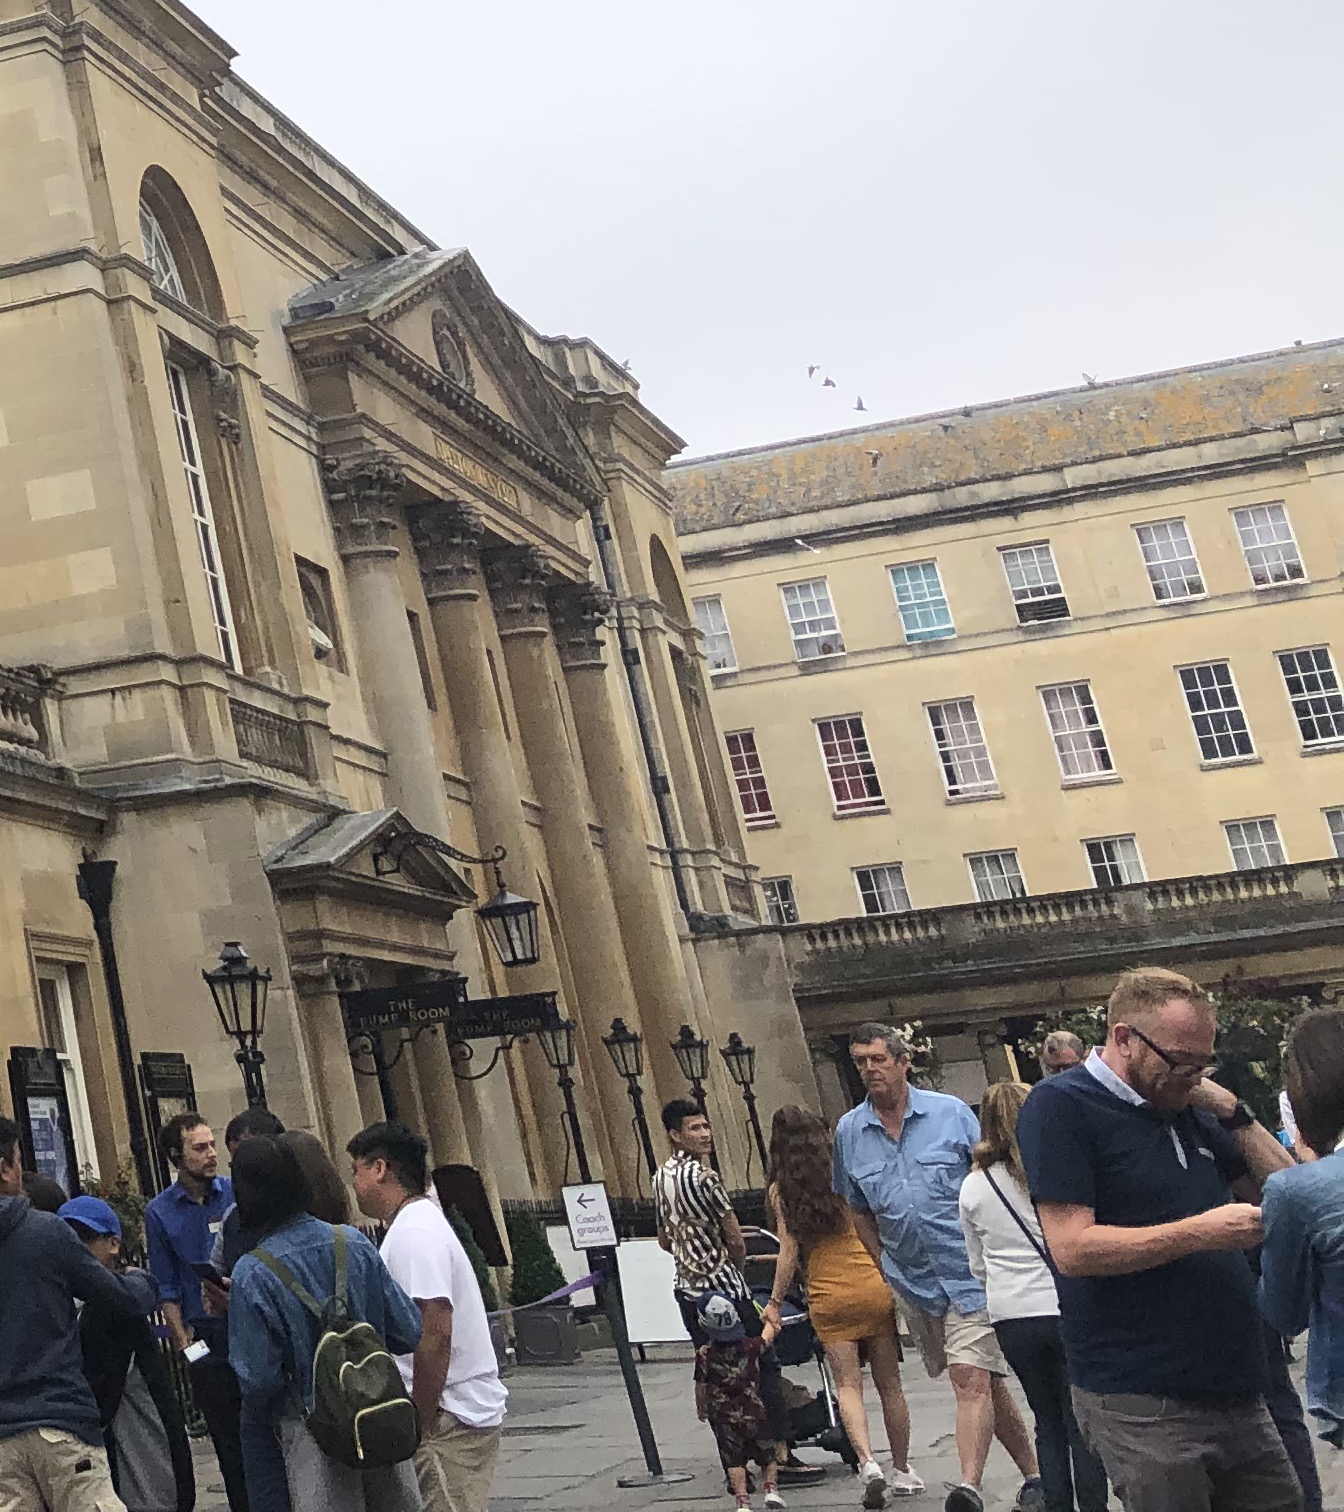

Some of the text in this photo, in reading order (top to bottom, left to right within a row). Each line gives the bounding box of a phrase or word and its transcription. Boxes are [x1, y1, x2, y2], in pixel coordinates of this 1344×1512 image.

[388, 998, 416, 1012] THE
[360, 1006, 450, 1028] PUMP ROOM
[575, 1212, 605, 1224] Coach
[577, 1226, 609, 1238] groups
